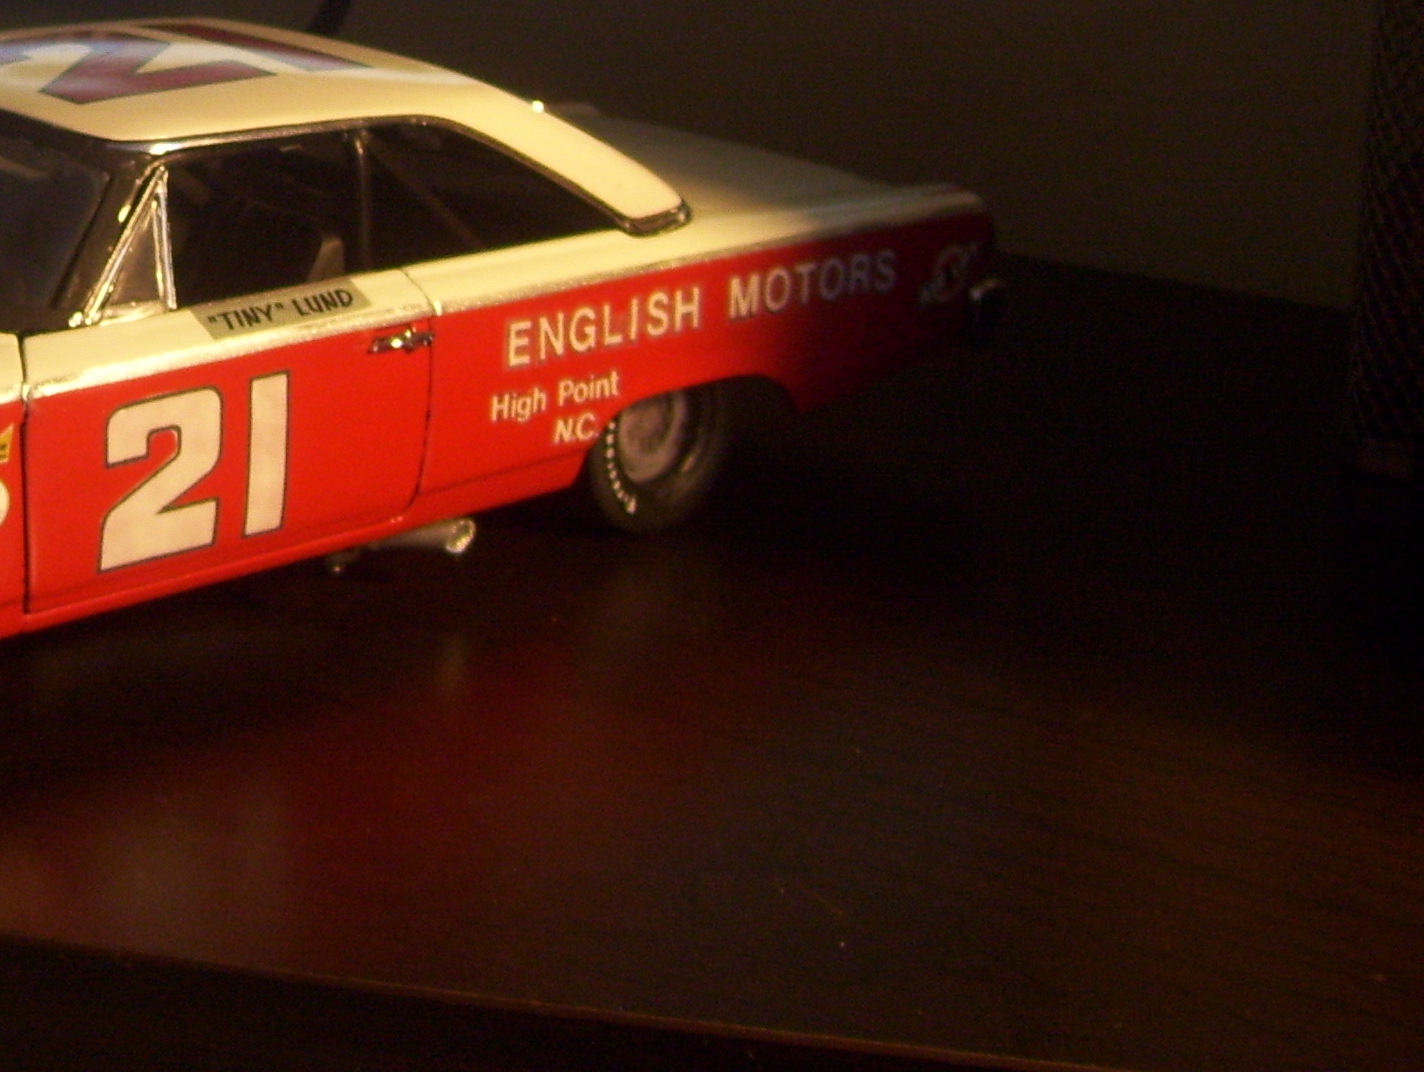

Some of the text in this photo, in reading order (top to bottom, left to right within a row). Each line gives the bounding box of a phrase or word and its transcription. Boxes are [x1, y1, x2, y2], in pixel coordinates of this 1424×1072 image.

[296, 289, 354, 317] LUND
[506, 251, 897, 368] ENGLISH MOTORS
[490, 370, 619, 424] High Point
[99, 370, 290, 574] 21
